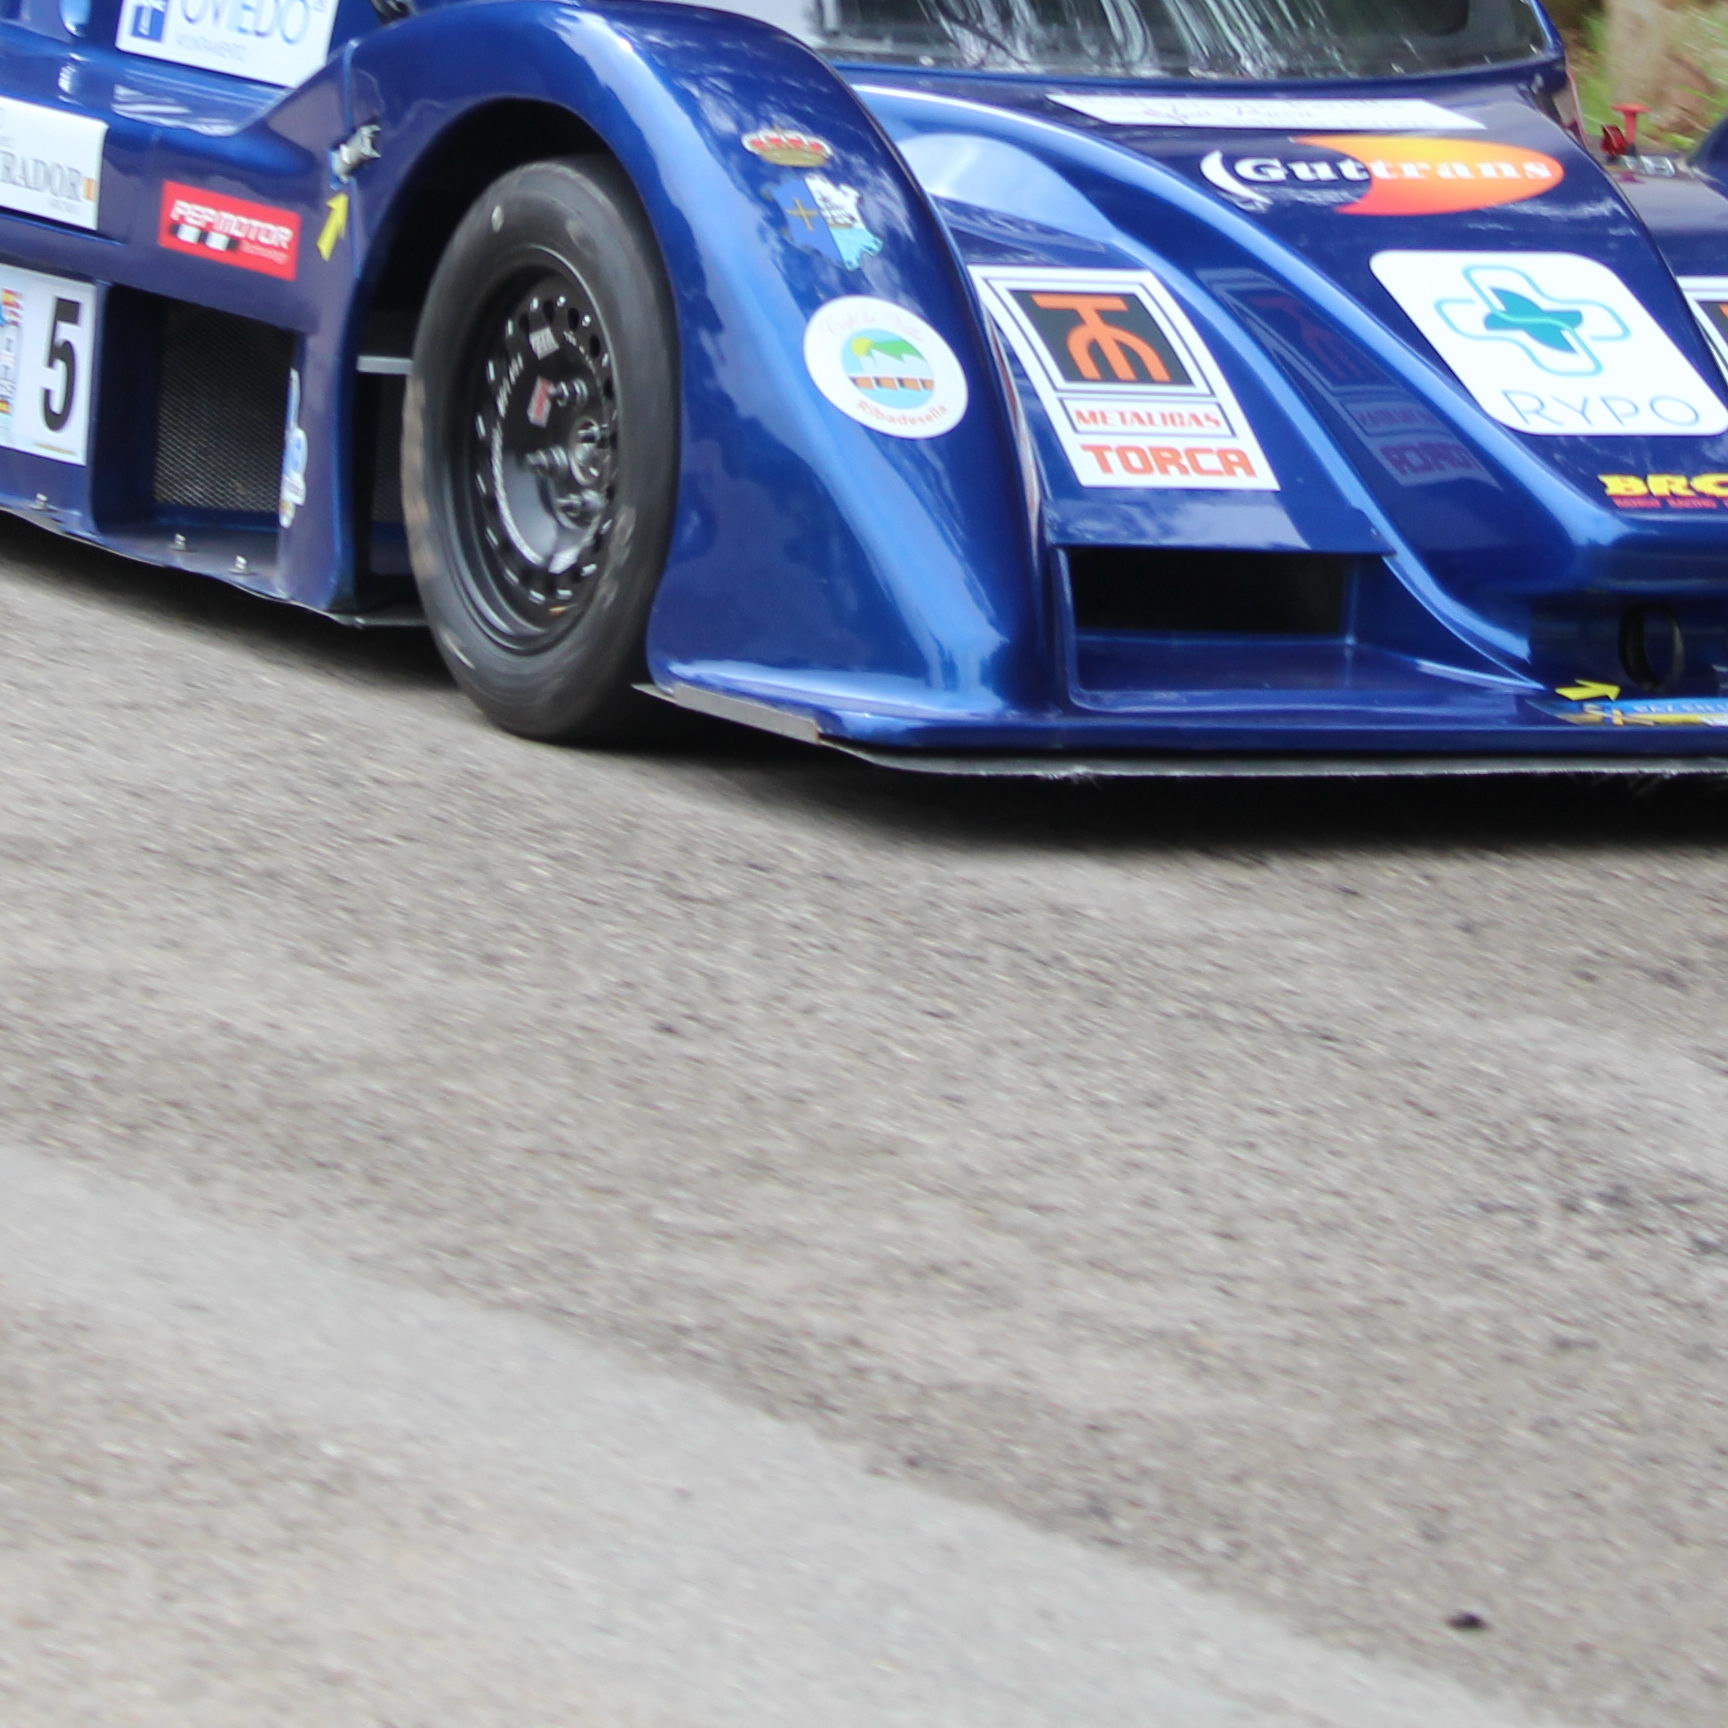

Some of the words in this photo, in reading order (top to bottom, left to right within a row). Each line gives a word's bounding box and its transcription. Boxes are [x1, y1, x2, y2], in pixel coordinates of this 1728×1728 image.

[1233, 156, 1553, 183] Guttrans
[41, 295, 83, 433] 5
[1500, 389, 1701, 428] RYPO
[1080, 445, 1257, 478] TORCA
